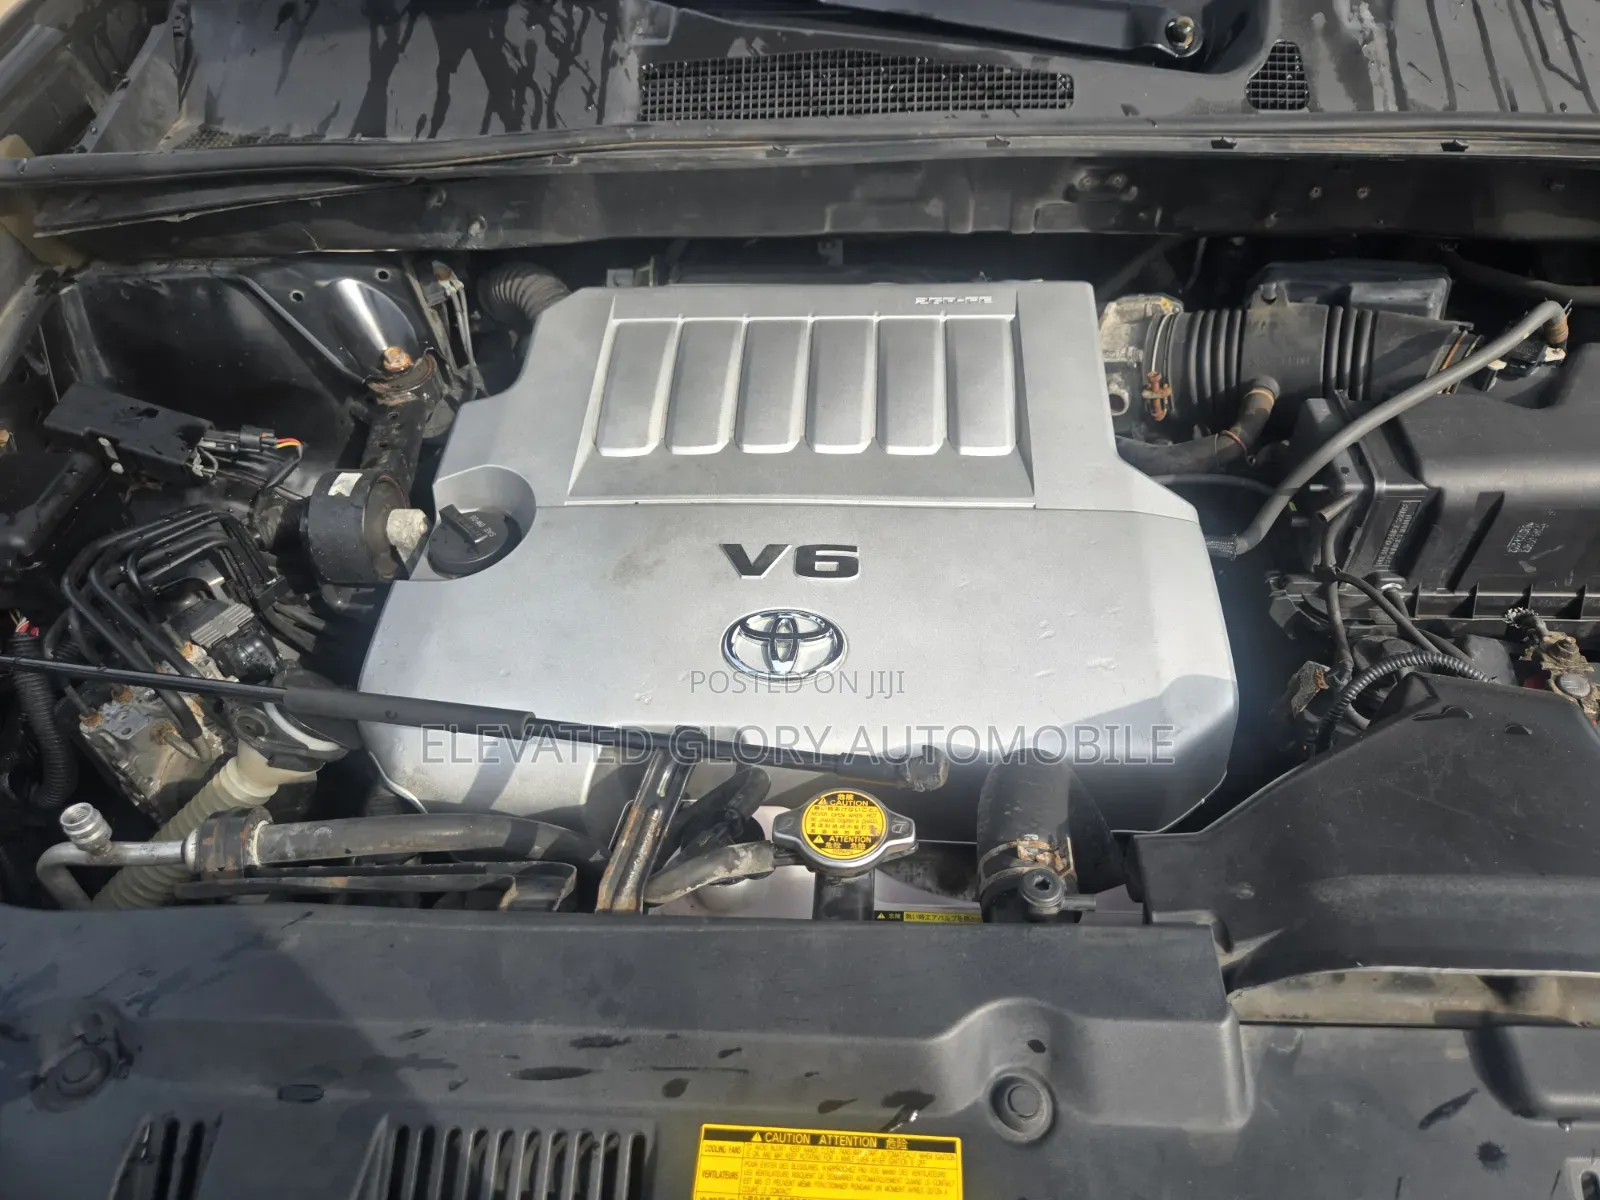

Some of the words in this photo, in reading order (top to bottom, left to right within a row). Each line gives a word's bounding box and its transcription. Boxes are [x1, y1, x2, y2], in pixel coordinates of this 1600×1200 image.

[719, 543, 860, 581] V6
[764, 1132, 810, 1144] CAUTION
[819, 1135, 877, 1148] ATTENTION
[705, 1144, 726, 1153] COOLING
[702, 1170, 738, 1180] VENTILATEURS
